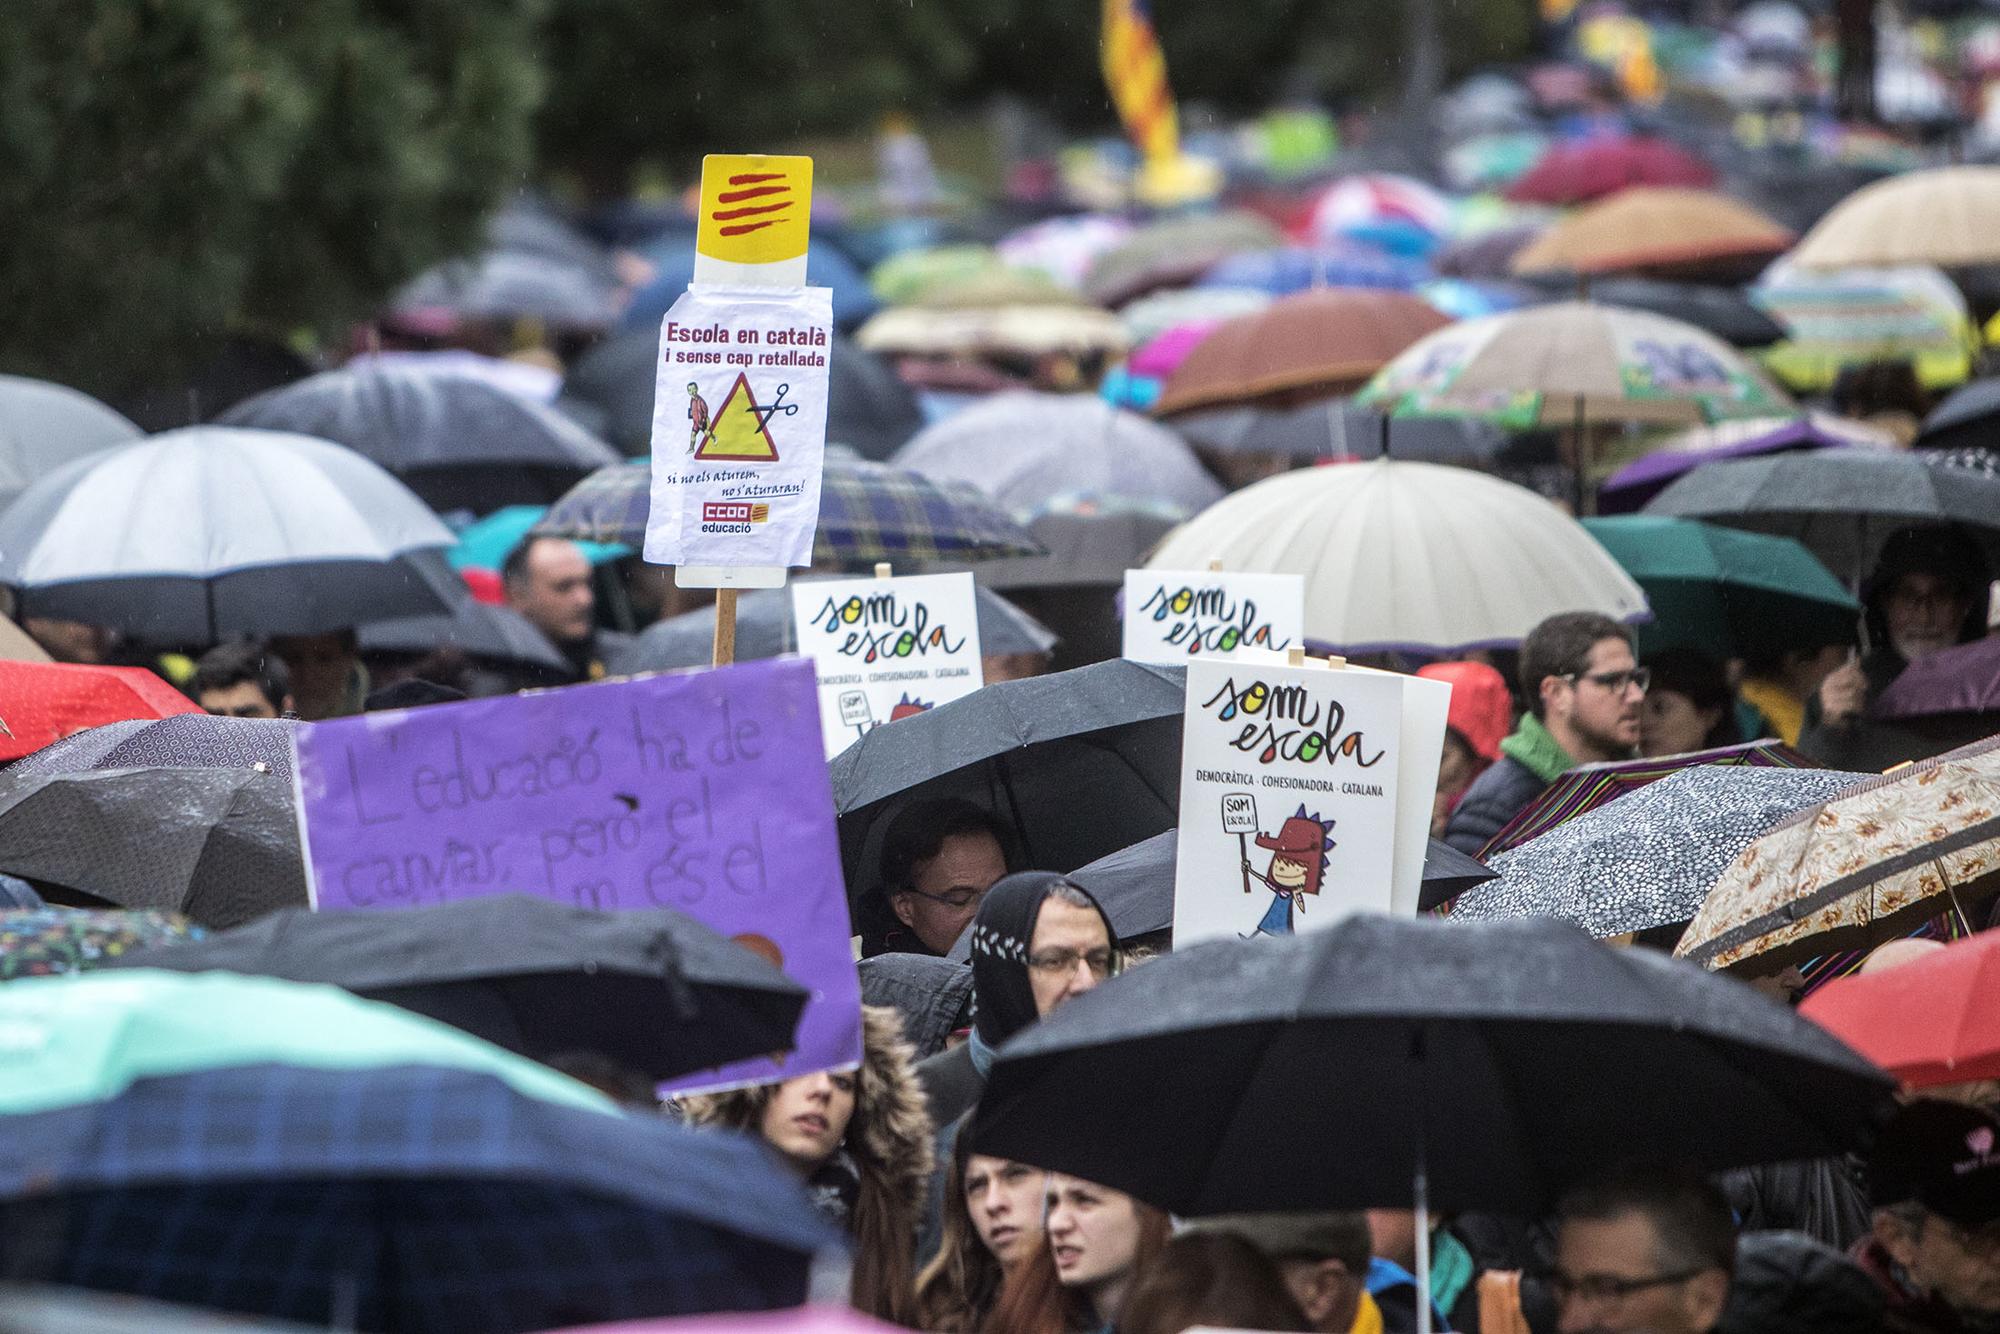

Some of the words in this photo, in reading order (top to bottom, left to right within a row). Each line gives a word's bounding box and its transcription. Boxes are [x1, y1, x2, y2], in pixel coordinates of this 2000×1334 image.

[666, 321, 729, 344] Escola
[737, 329, 759, 344] en
[766, 326, 826, 346] català
[665, 347, 671, 362] i
[676, 350, 721, 364] sense
[726, 352, 753, 368] cap
[758, 351, 825, 367] retallada
[680, 474, 694, 485] no
[695, 470, 711, 484] els
[713, 470, 760, 482] aturem,
[721, 486, 735, 497] no
[701, 522, 752, 534] educació
[705, 506, 749, 519] CCOO
[811, 592, 908, 633] som
[1139, 584, 1237, 622] som
[837, 602, 966, 664] escola
[1162, 599, 1291, 655] escola
[1201, 677, 1320, 727] som
[632, 704, 696, 776] ha
[708, 700, 764, 768] de
[1229, 700, 1386, 768] escola
[1196, 769, 1255, 786] DEMOCRÀTICA
[1261, 775, 1334, 793] COHESIONADORA
[1341, 782, 1384, 797] CATALANA
[666, 776, 715, 843] el
[1226, 798, 1250, 812] SOM
[645, 842, 707, 908] és
[724, 818, 768, 896] el
